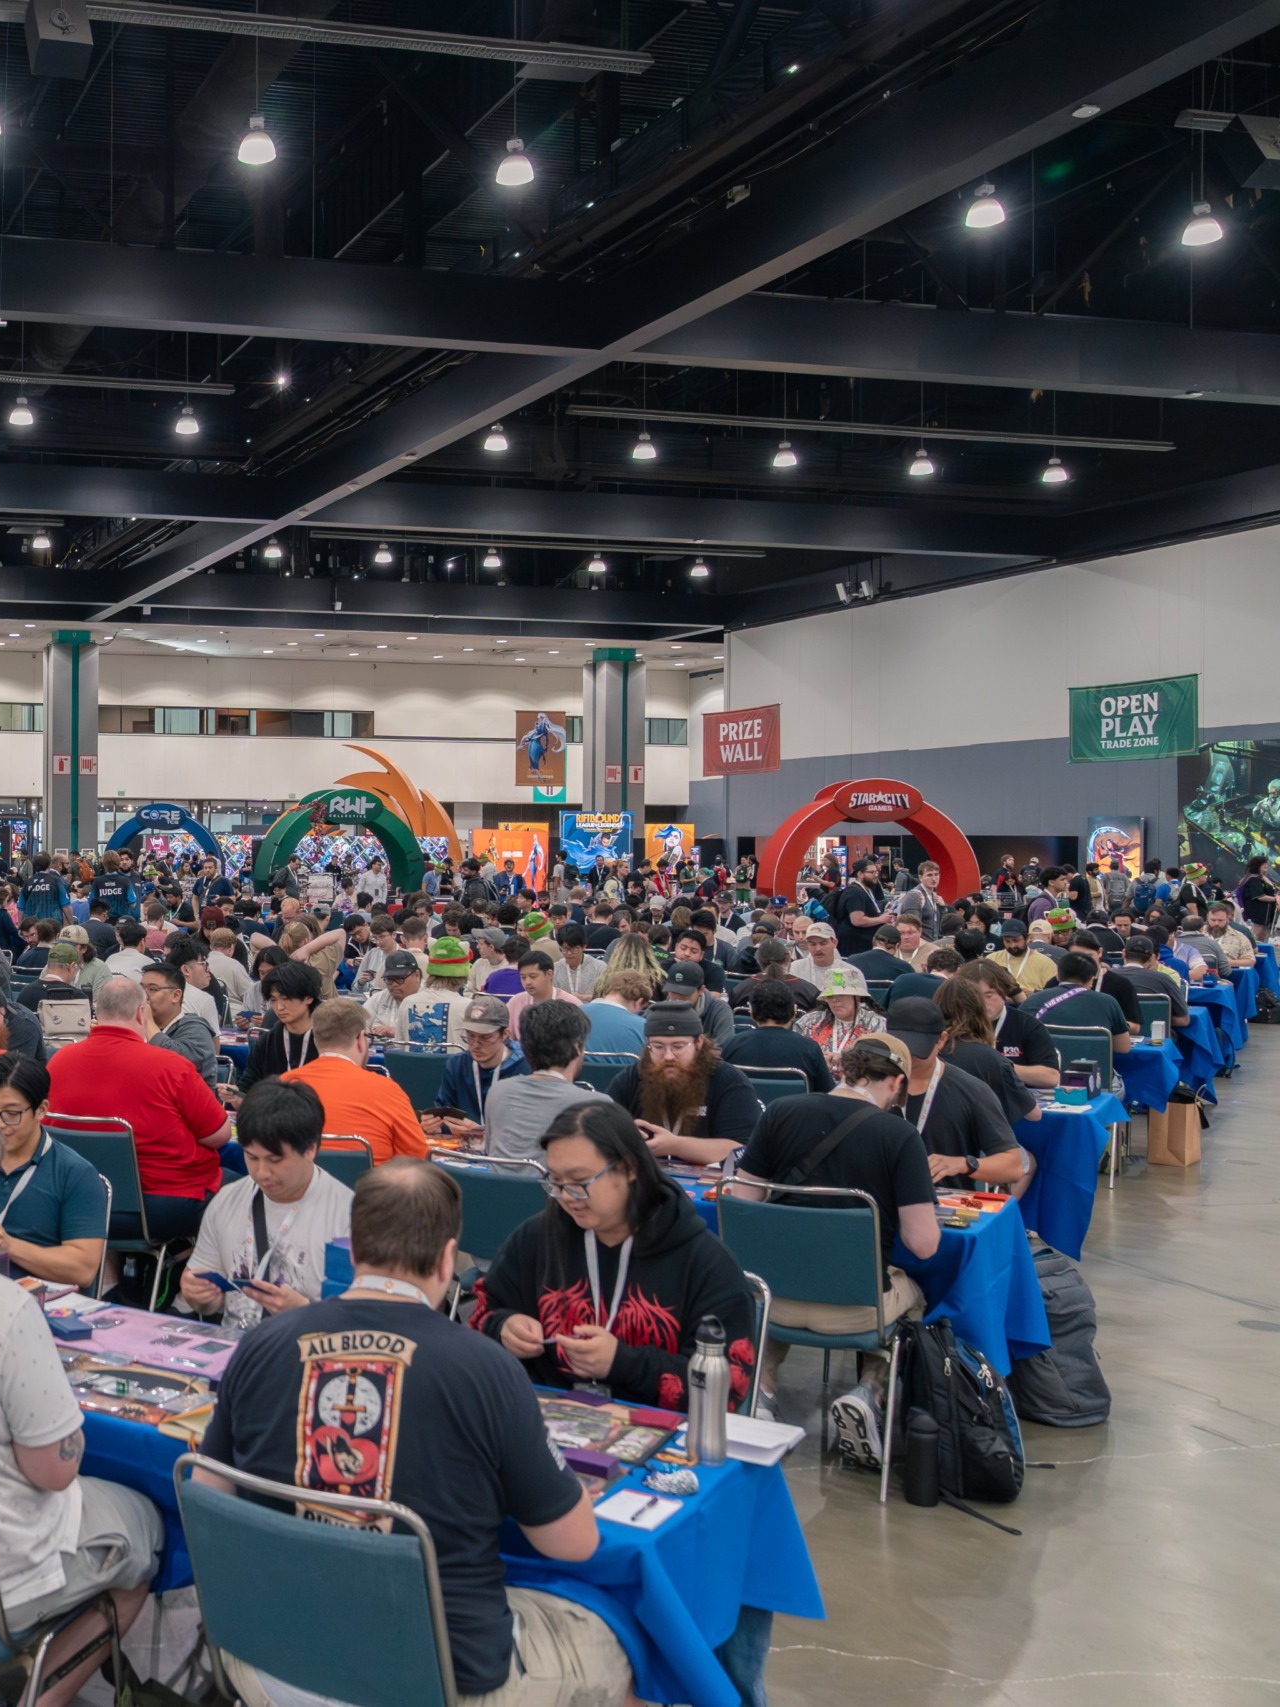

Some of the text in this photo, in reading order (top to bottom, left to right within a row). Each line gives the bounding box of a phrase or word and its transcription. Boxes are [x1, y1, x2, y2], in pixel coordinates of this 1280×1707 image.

[1101, 692, 1158, 716] OPEN
[719, 719, 762, 742] PRIZE
[1101, 714, 1159, 738] PLAY
[1100, 737, 1159, 749] TRADE ZONE
[720, 742, 762, 763] WALL
[849, 793, 910, 809] STAR CITY
[141, 809, 181, 820] CORE
[576, 813, 620, 823] RIFTBOUND
[100, 887, 122, 896] JUDGE
[307, 1333, 405, 1357] ALL BLOOD
